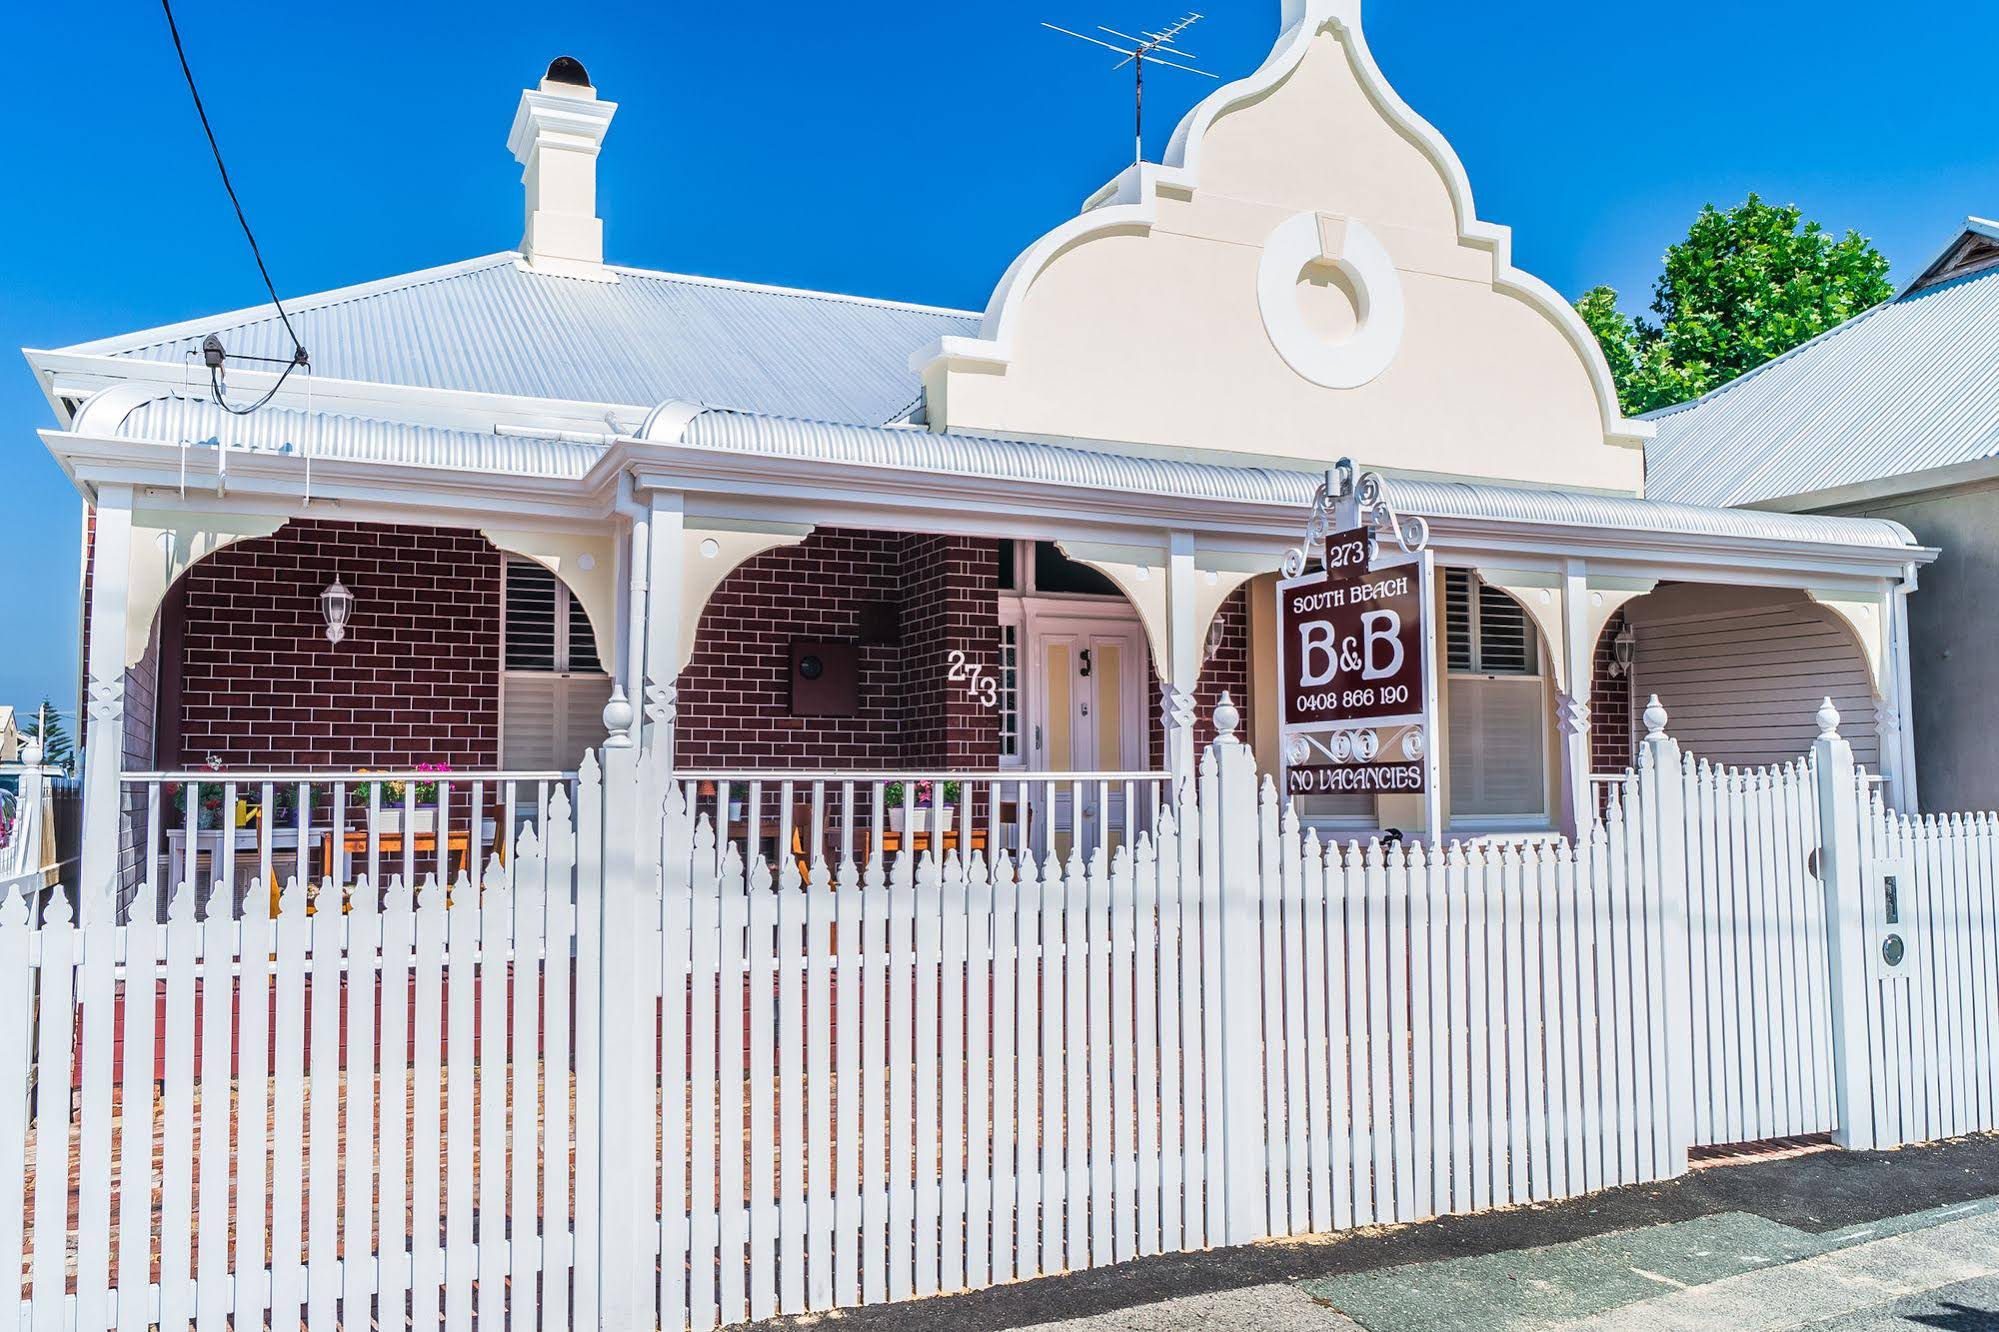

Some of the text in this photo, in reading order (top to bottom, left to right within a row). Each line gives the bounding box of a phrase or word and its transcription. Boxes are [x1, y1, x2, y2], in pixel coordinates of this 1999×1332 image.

[1330, 541, 1364, 569] 273
[1293, 576, 1408, 614] SOUTH BEACH
[1299, 609, 1404, 687] B&B
[948, 650, 997, 707] 273
[1297, 685, 1408, 711] 0408 866 190
[1290, 766, 1422, 793] NO VACANCIES
